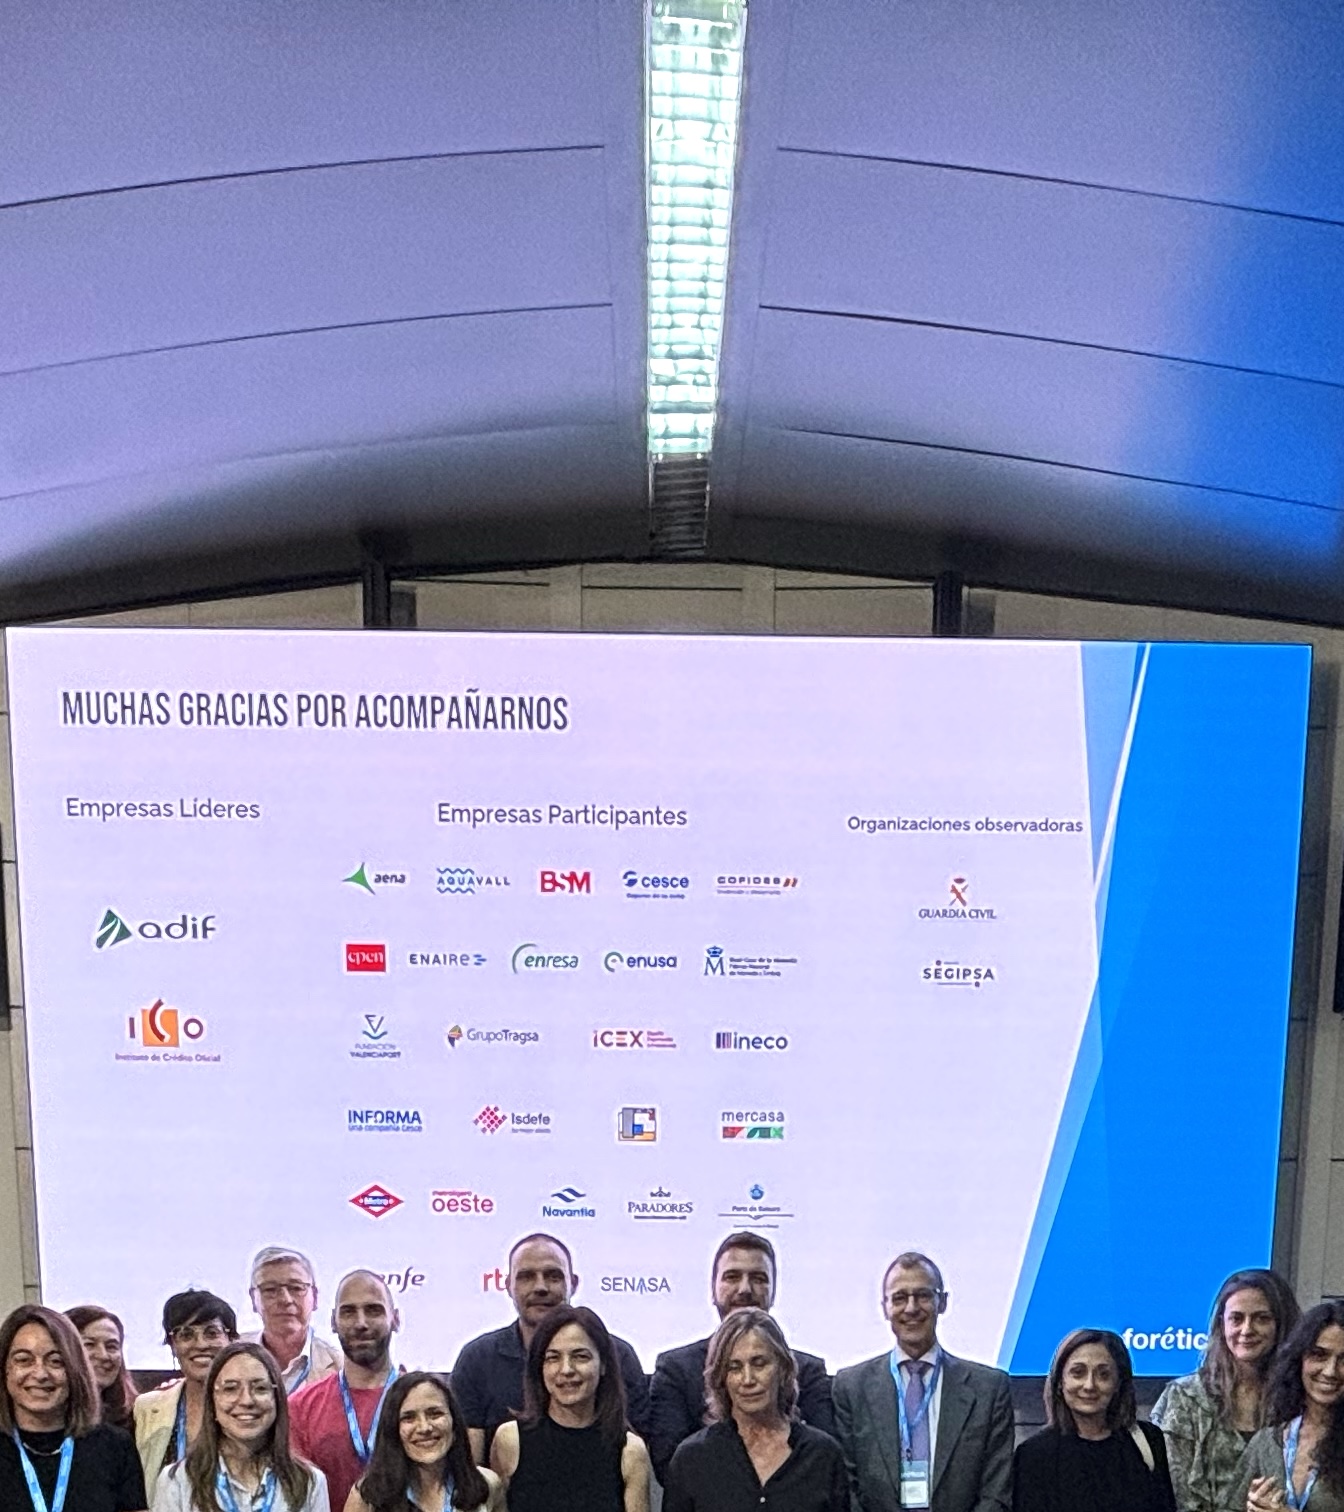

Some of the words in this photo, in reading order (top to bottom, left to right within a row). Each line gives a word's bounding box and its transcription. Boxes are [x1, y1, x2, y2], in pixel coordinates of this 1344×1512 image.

[62, 691, 171, 725] MUCHAS
[179, 692, 288, 726] GRACIAS
[297, 694, 347, 728] POR
[355, 688, 568, 730] ACOMPAÑARNOS
[66, 797, 174, 822] Empresas
[179, 797, 261, 819] Líderes
[438, 802, 542, 829] Empresas
[548, 804, 688, 831] Participantes
[847, 816, 971, 833] Organizaciones
[975, 817, 1083, 832] observadoras
[374, 873, 406, 884] aena
[437, 876, 511, 886] AQUAVALL
[540, 870, 591, 893] BSM
[641, 876, 690, 889] cesce
[918, 908, 967, 919] GUARDIA
[968, 908, 997, 920] CIVIL
[138, 914, 216, 940] adif
[524, 954, 579, 968] enresa
[626, 956, 678, 968] enusa
[922, 967, 995, 980] SEGIPSA
[466, 1028, 539, 1044] GrupoTragsa
[733, 1032, 788, 1050] ineco
[348, 1109, 422, 1125] INFORMA
[511, 1113, 550, 1125] Isdefe
[721, 1111, 785, 1122] mercasa
[432, 1195, 494, 1213] oeste
[542, 1205, 596, 1217] Navantia
[600, 1276, 671, 1295] SENASA
[1122, 1326, 1210, 1351] forétic
